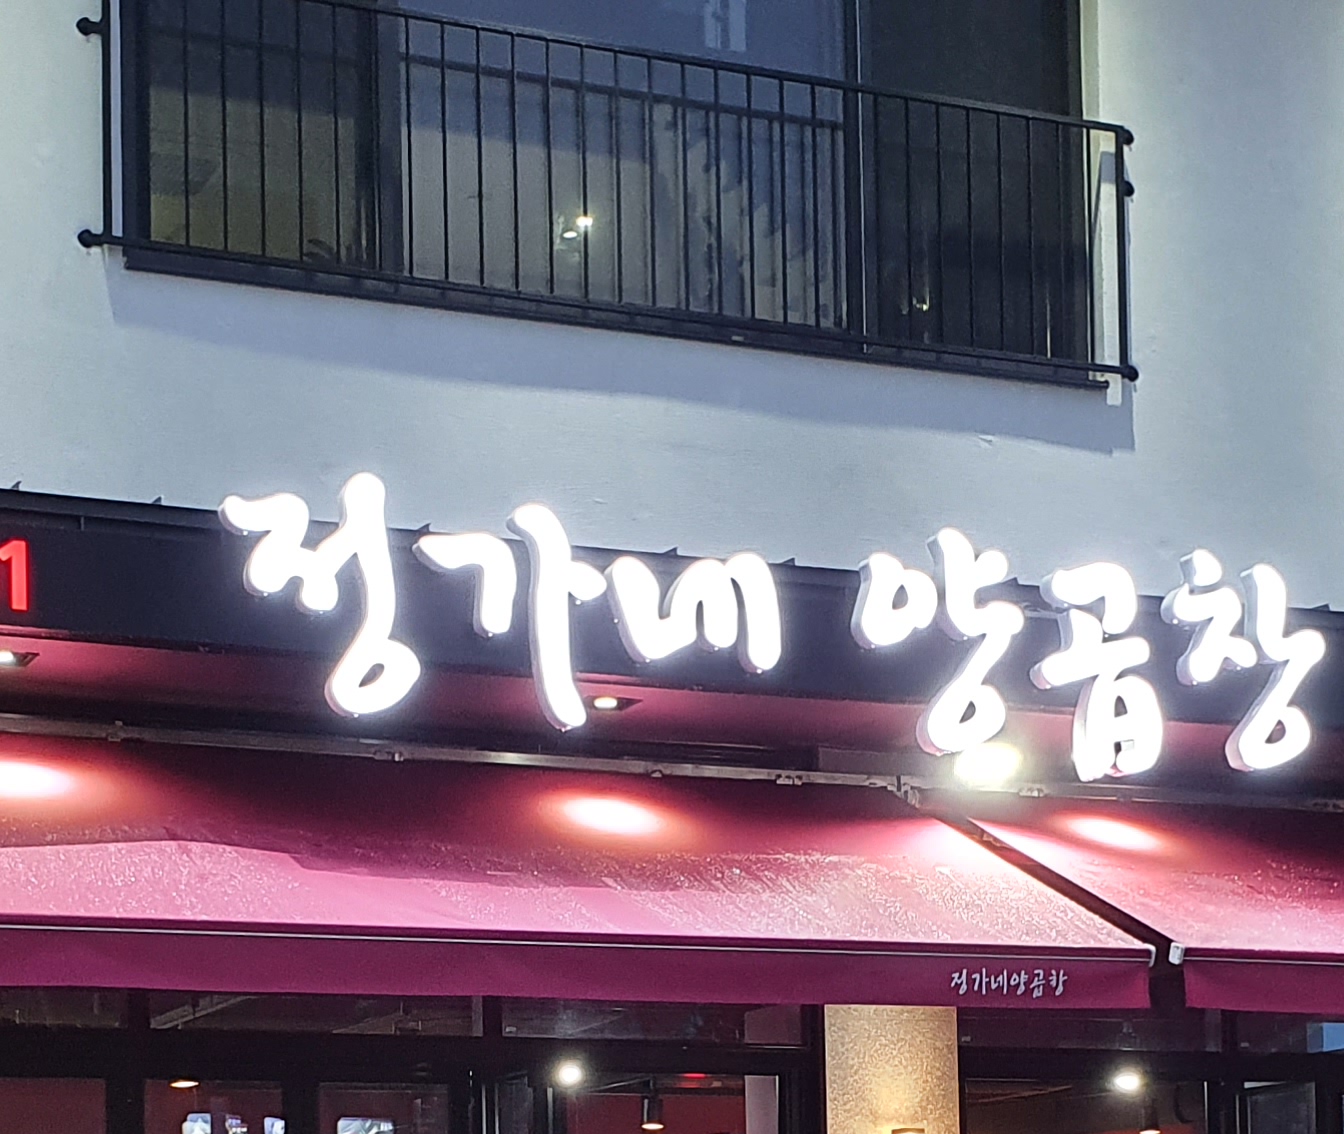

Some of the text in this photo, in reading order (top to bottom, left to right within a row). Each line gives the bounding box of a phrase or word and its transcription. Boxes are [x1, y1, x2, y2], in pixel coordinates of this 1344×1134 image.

[218, 472, 1326, 782] 정가네 양곱창
[950, 968, 1068, 998] 정가네양곱창
